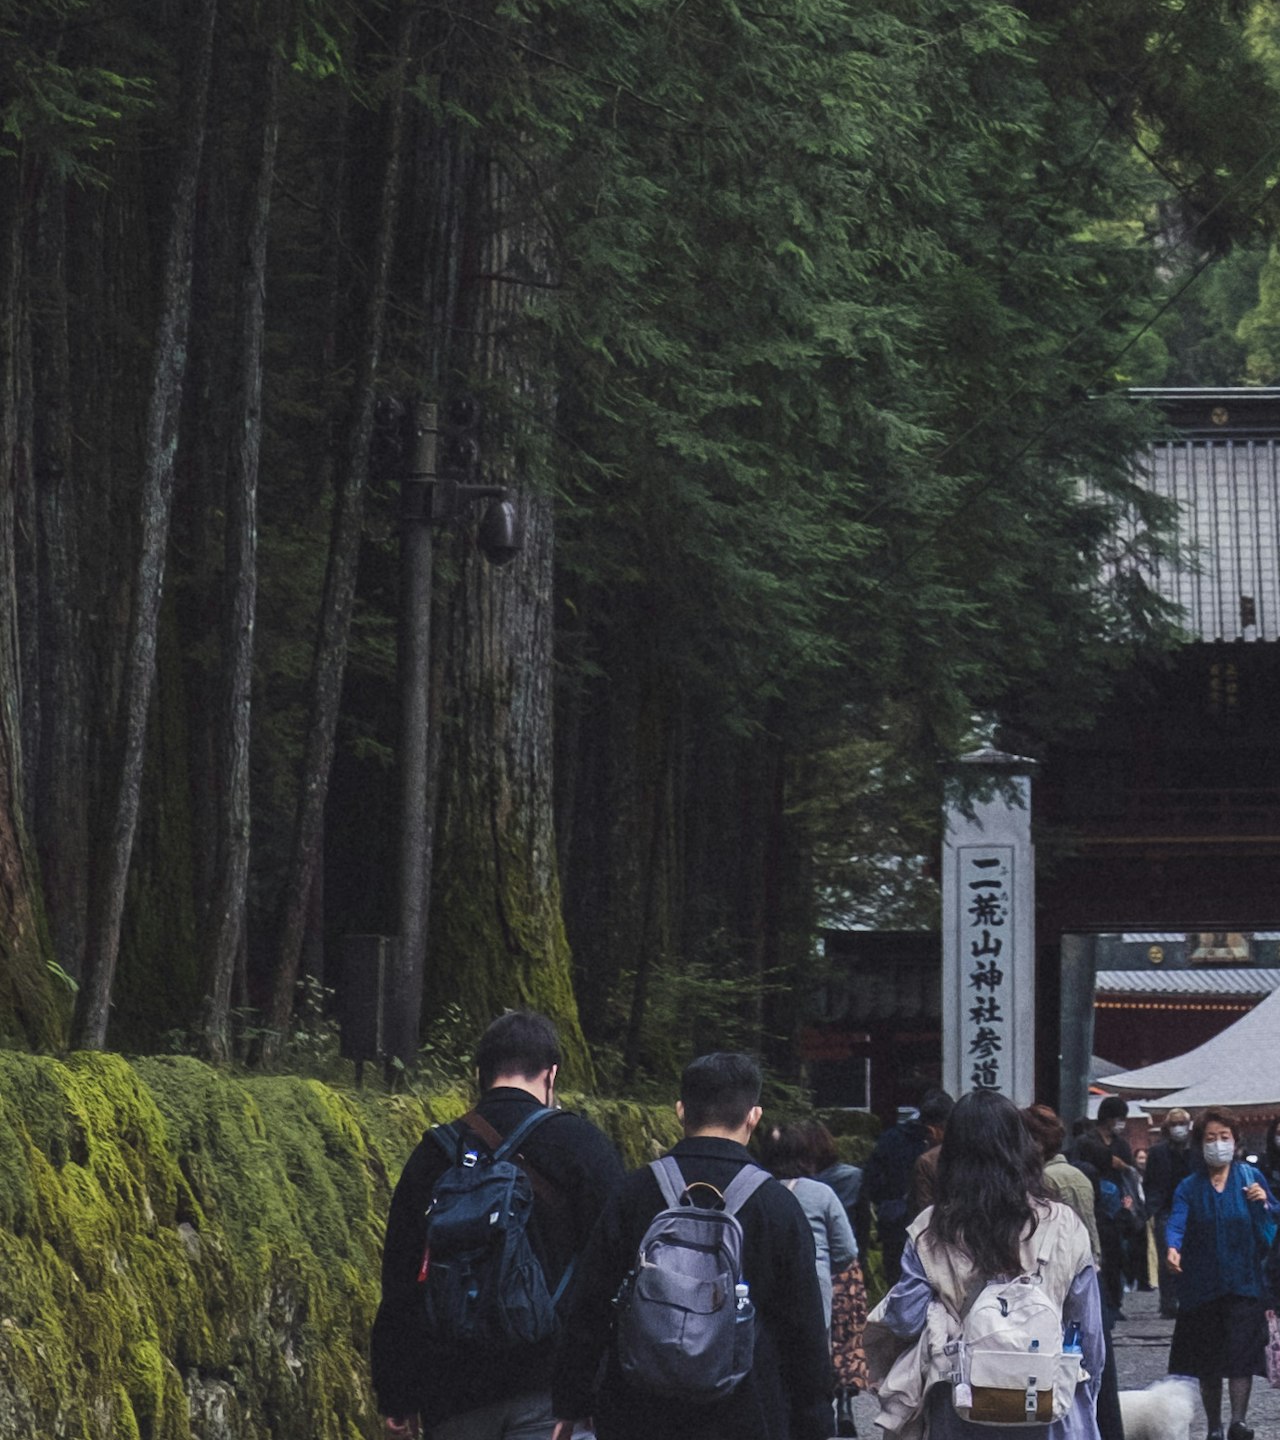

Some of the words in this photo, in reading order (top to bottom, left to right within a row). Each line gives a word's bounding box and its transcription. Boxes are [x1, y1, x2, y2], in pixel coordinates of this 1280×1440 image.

[968, 858, 1004, 1091] 二荒山神社参道
